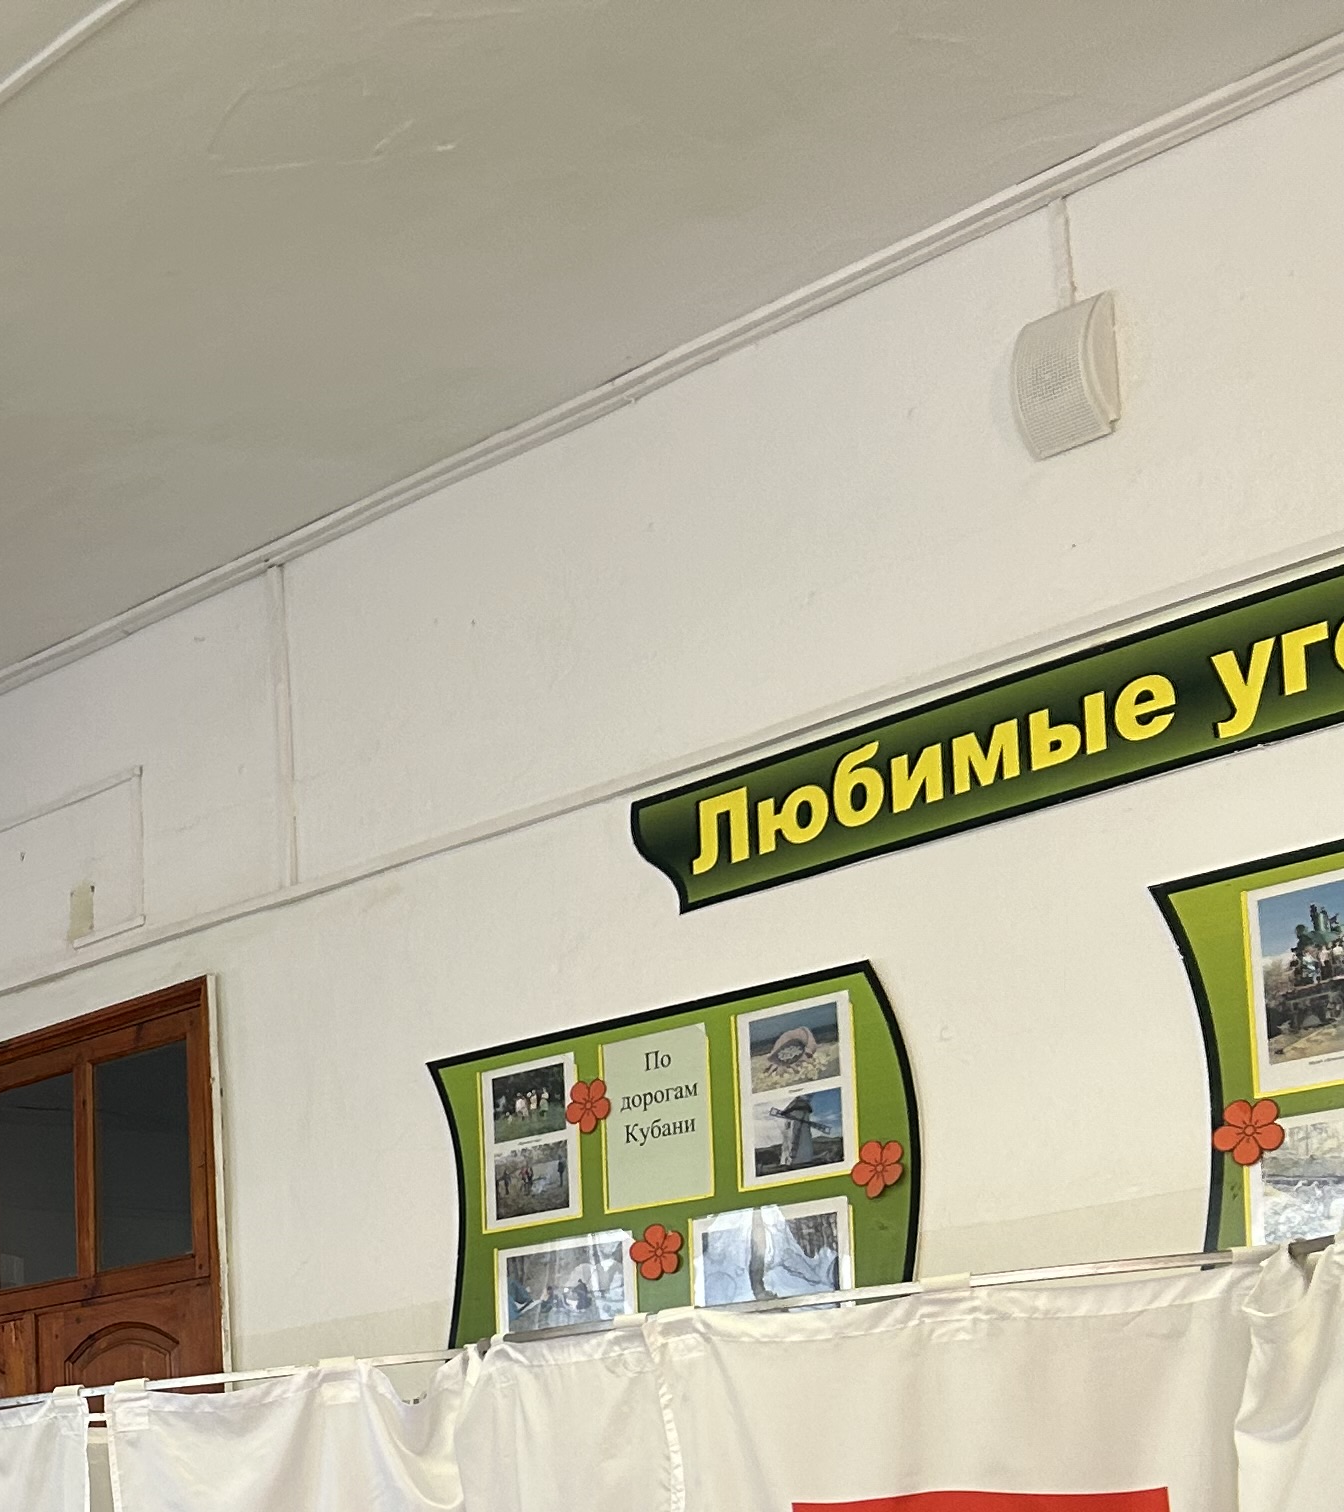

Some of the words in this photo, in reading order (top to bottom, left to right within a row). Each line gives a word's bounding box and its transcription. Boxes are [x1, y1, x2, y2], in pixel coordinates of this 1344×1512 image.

[692, 675, 1176, 875] Любимые
[1212, 623, 1344, 739] уг
[645, 1050, 672, 1072] По
[620, 1082, 698, 1112] дорогам
[625, 1117, 696, 1147] Кубани
